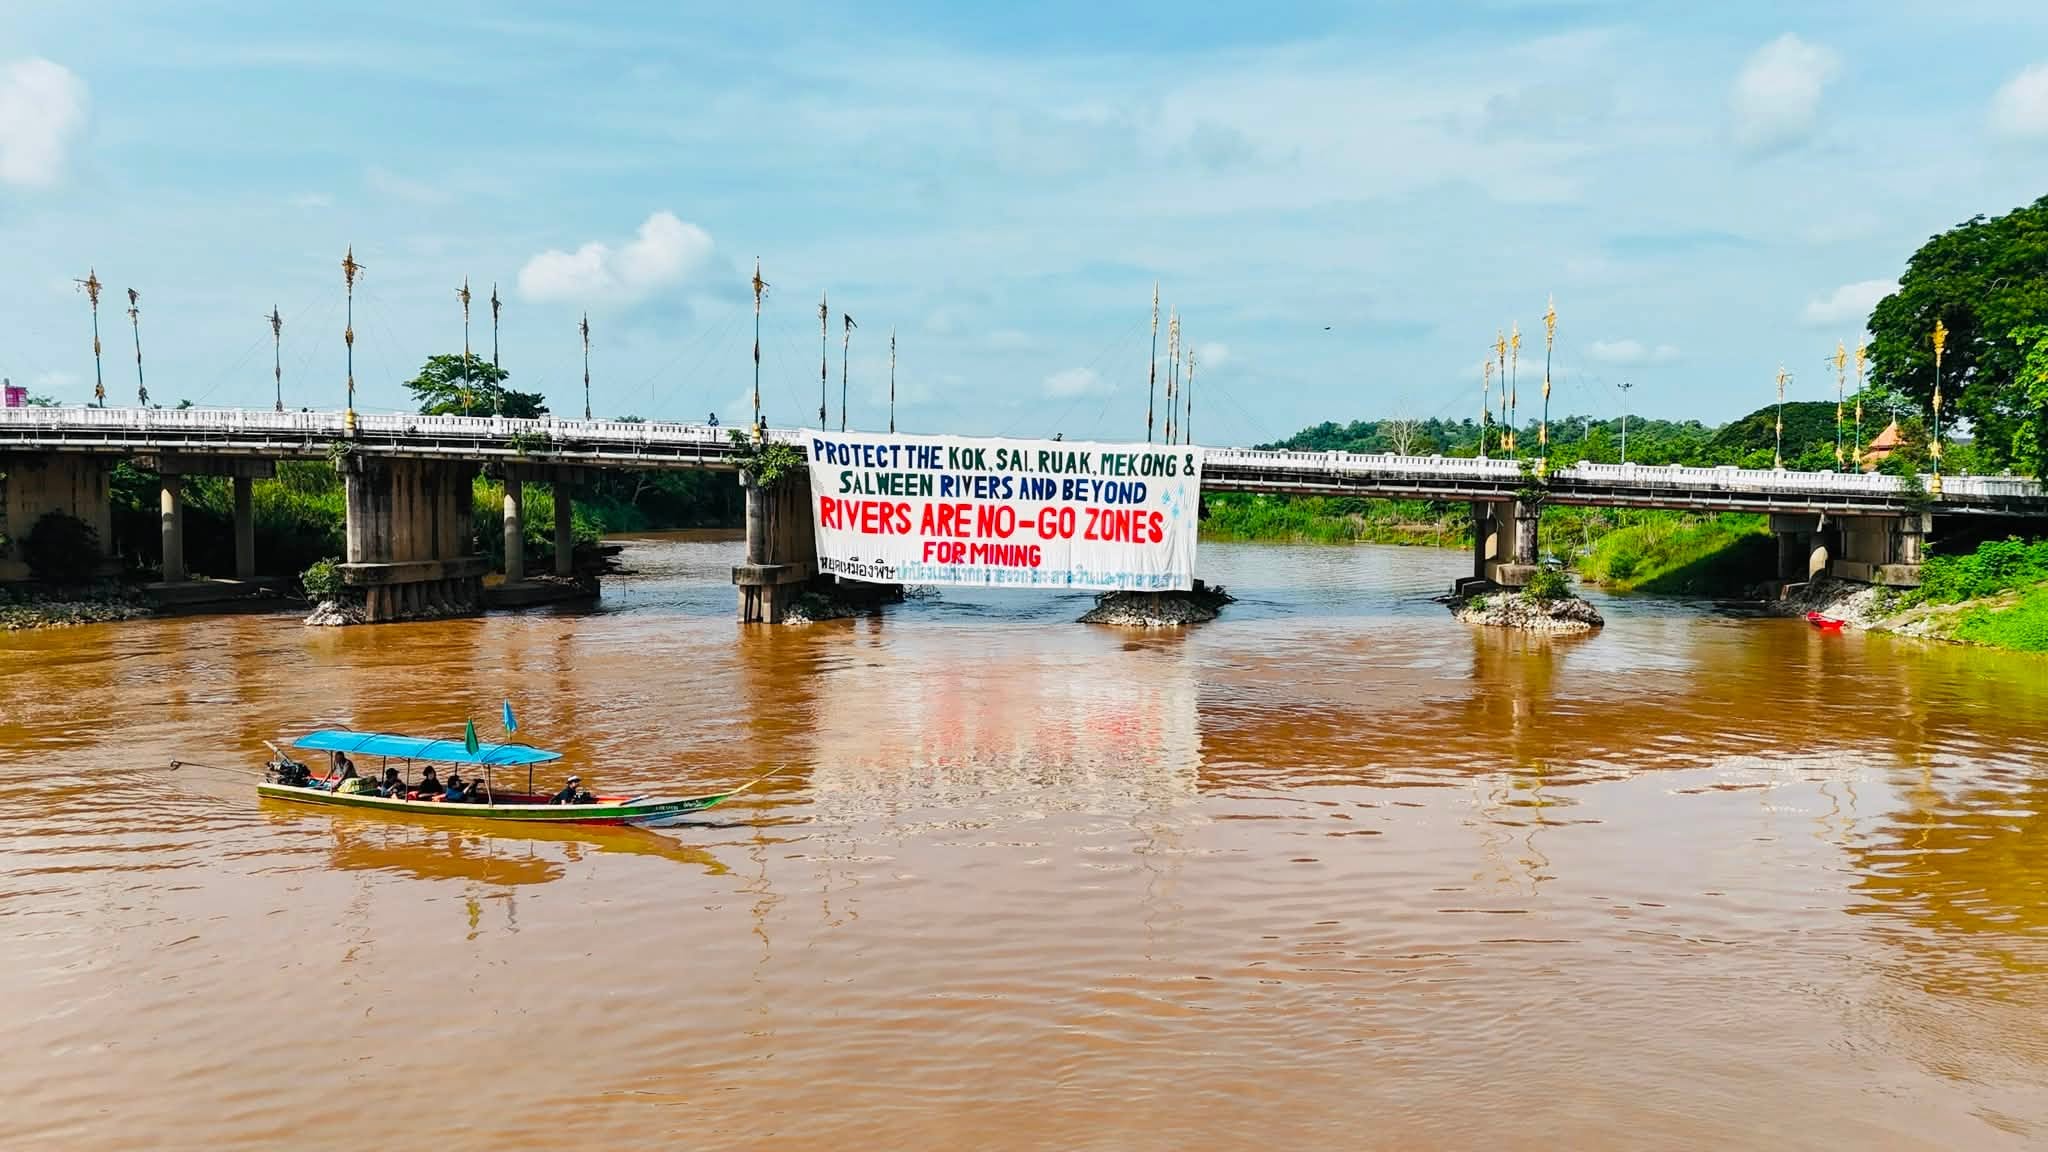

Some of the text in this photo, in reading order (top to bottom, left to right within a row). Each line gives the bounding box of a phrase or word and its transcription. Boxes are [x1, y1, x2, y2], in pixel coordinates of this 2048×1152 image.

[813, 438, 900, 469] PROTECT
[905, 445, 943, 469] THE
[1100, 453, 1177, 477] MEKONG
[1183, 454, 1195, 476] &
[839, 470, 1147, 504] SALWEEN RIVERS AND BEYOND
[820, 496, 1163, 544] RIVERS ARE NO-GO ZONES
[923, 541, 1041, 567] FOR MINING
